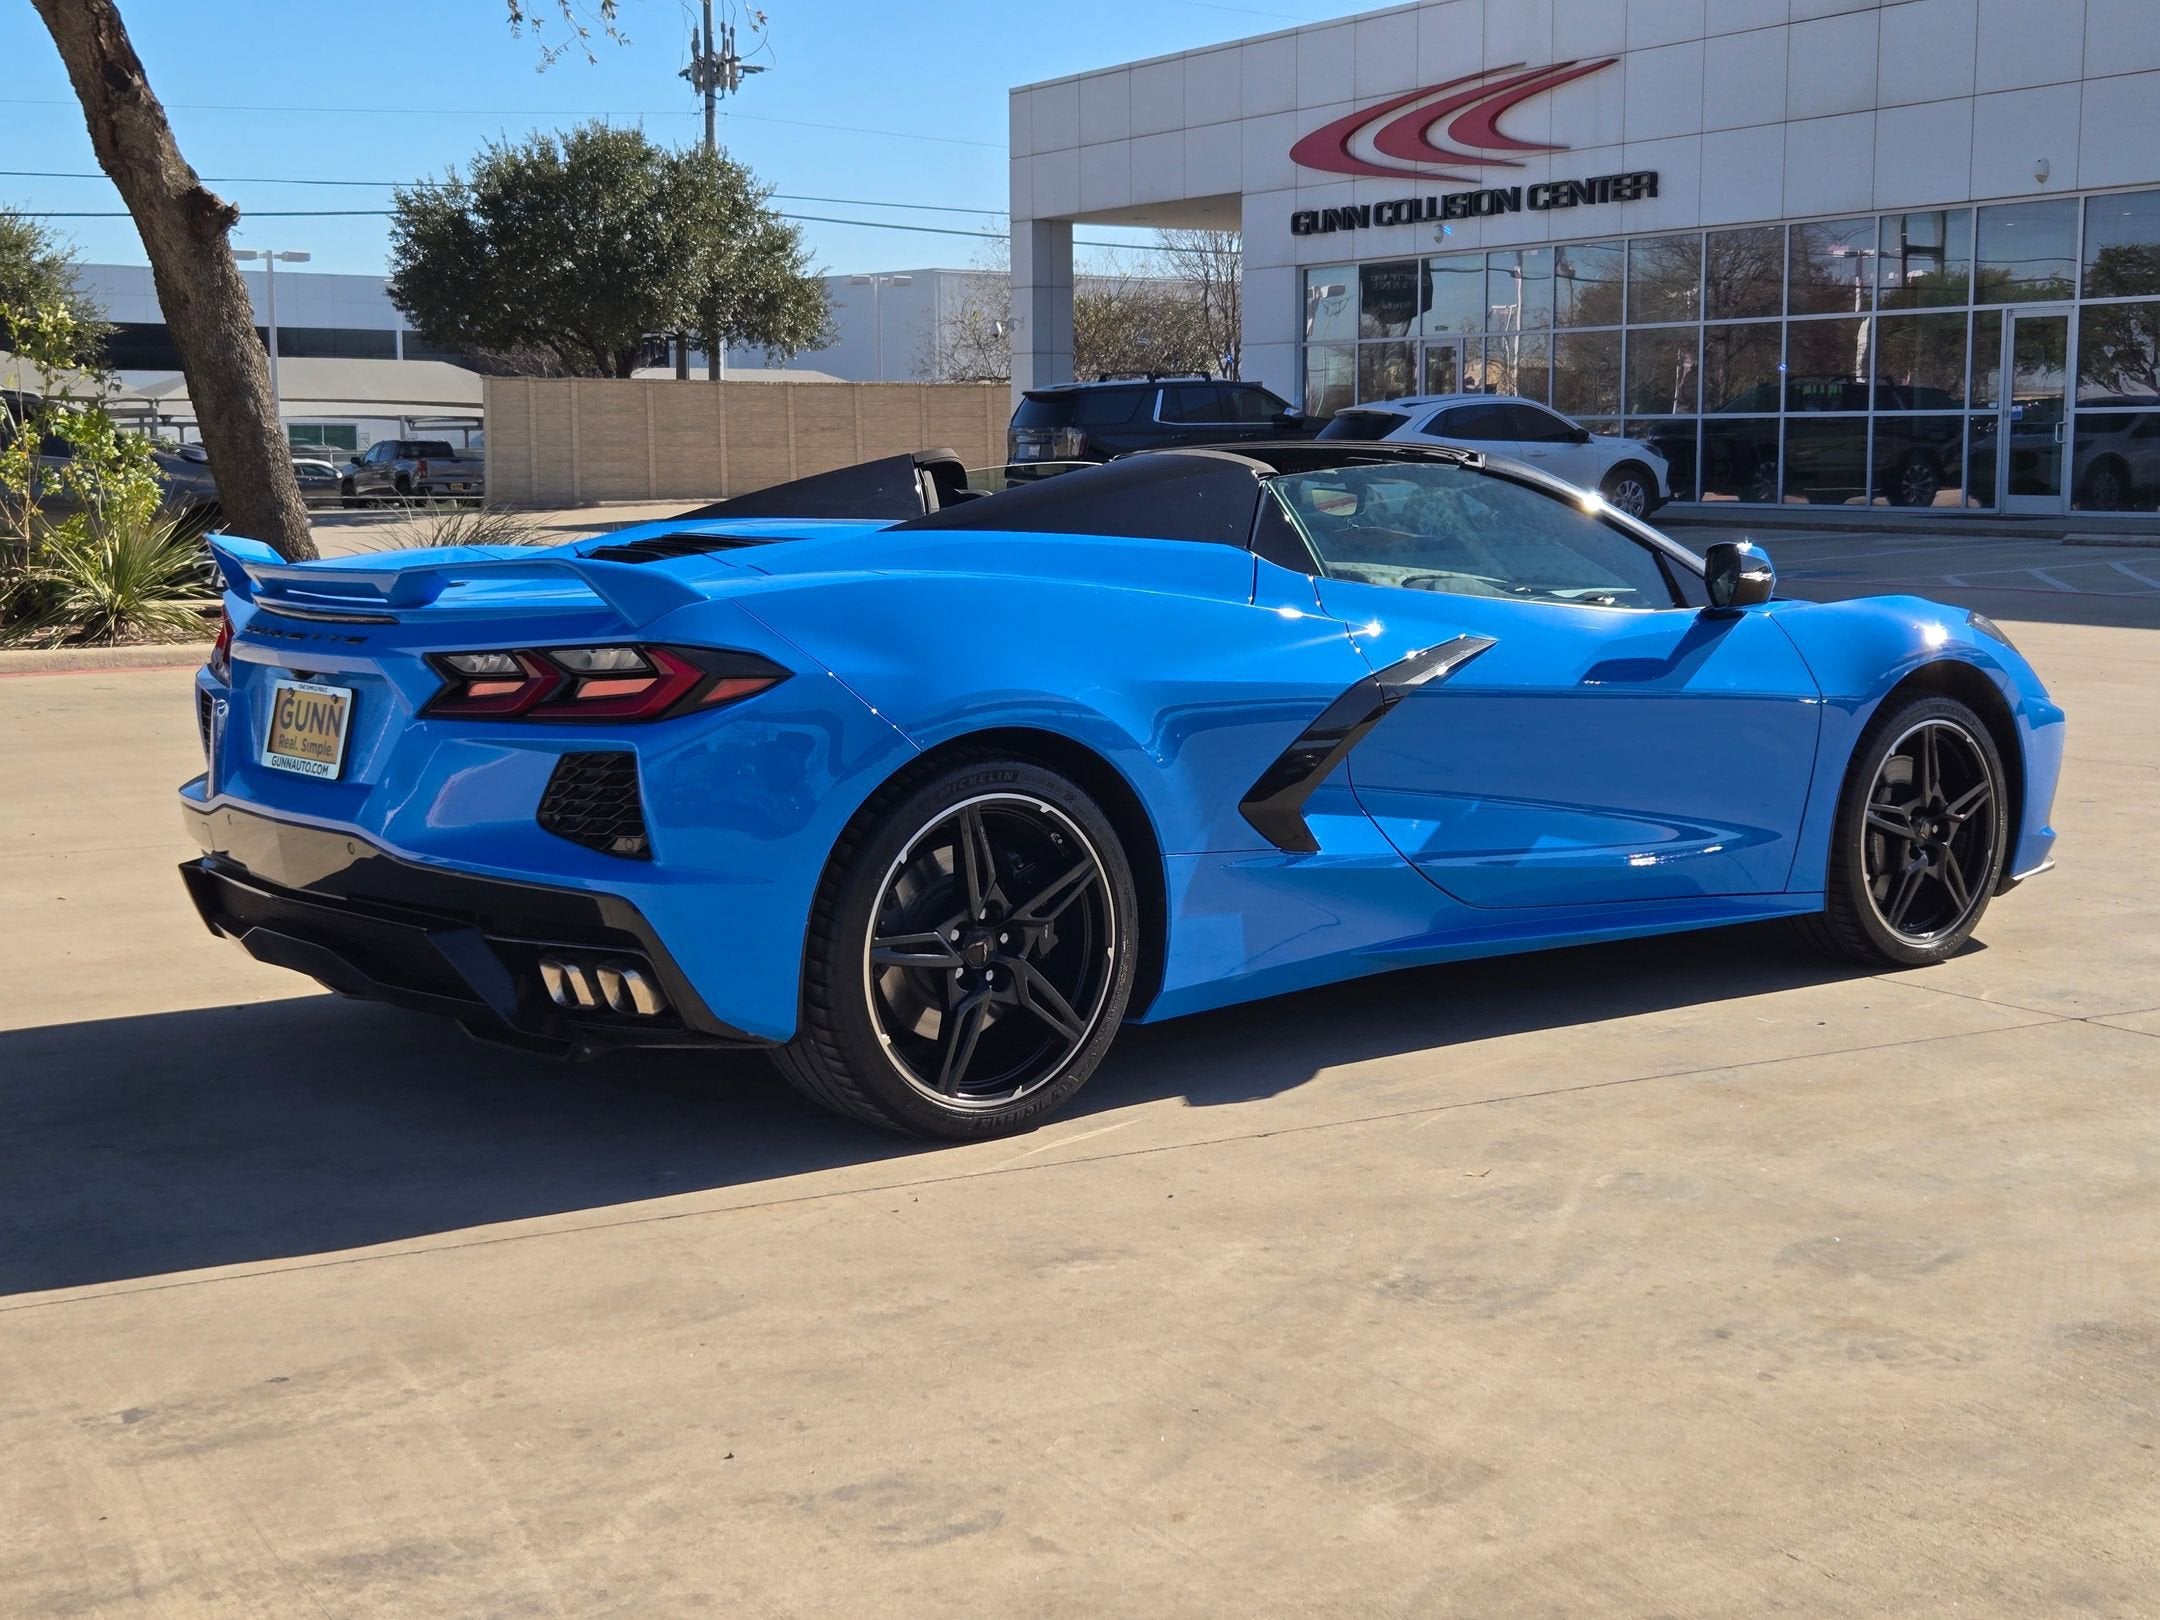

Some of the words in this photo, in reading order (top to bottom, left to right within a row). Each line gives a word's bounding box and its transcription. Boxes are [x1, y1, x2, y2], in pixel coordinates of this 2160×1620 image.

[1290, 205, 1370, 236] GUNN
[1373, 186, 1521, 227] COLLISION
[1526, 171, 1659, 211] CENTER
[280, 698, 344, 737] GUNN
[278, 734, 298, 750] Real.
[301, 739, 334, 758] Simple.
[271, 756, 329, 777] GUNNAUTO.COM
[938, 770, 1013, 798] MICHELIN
